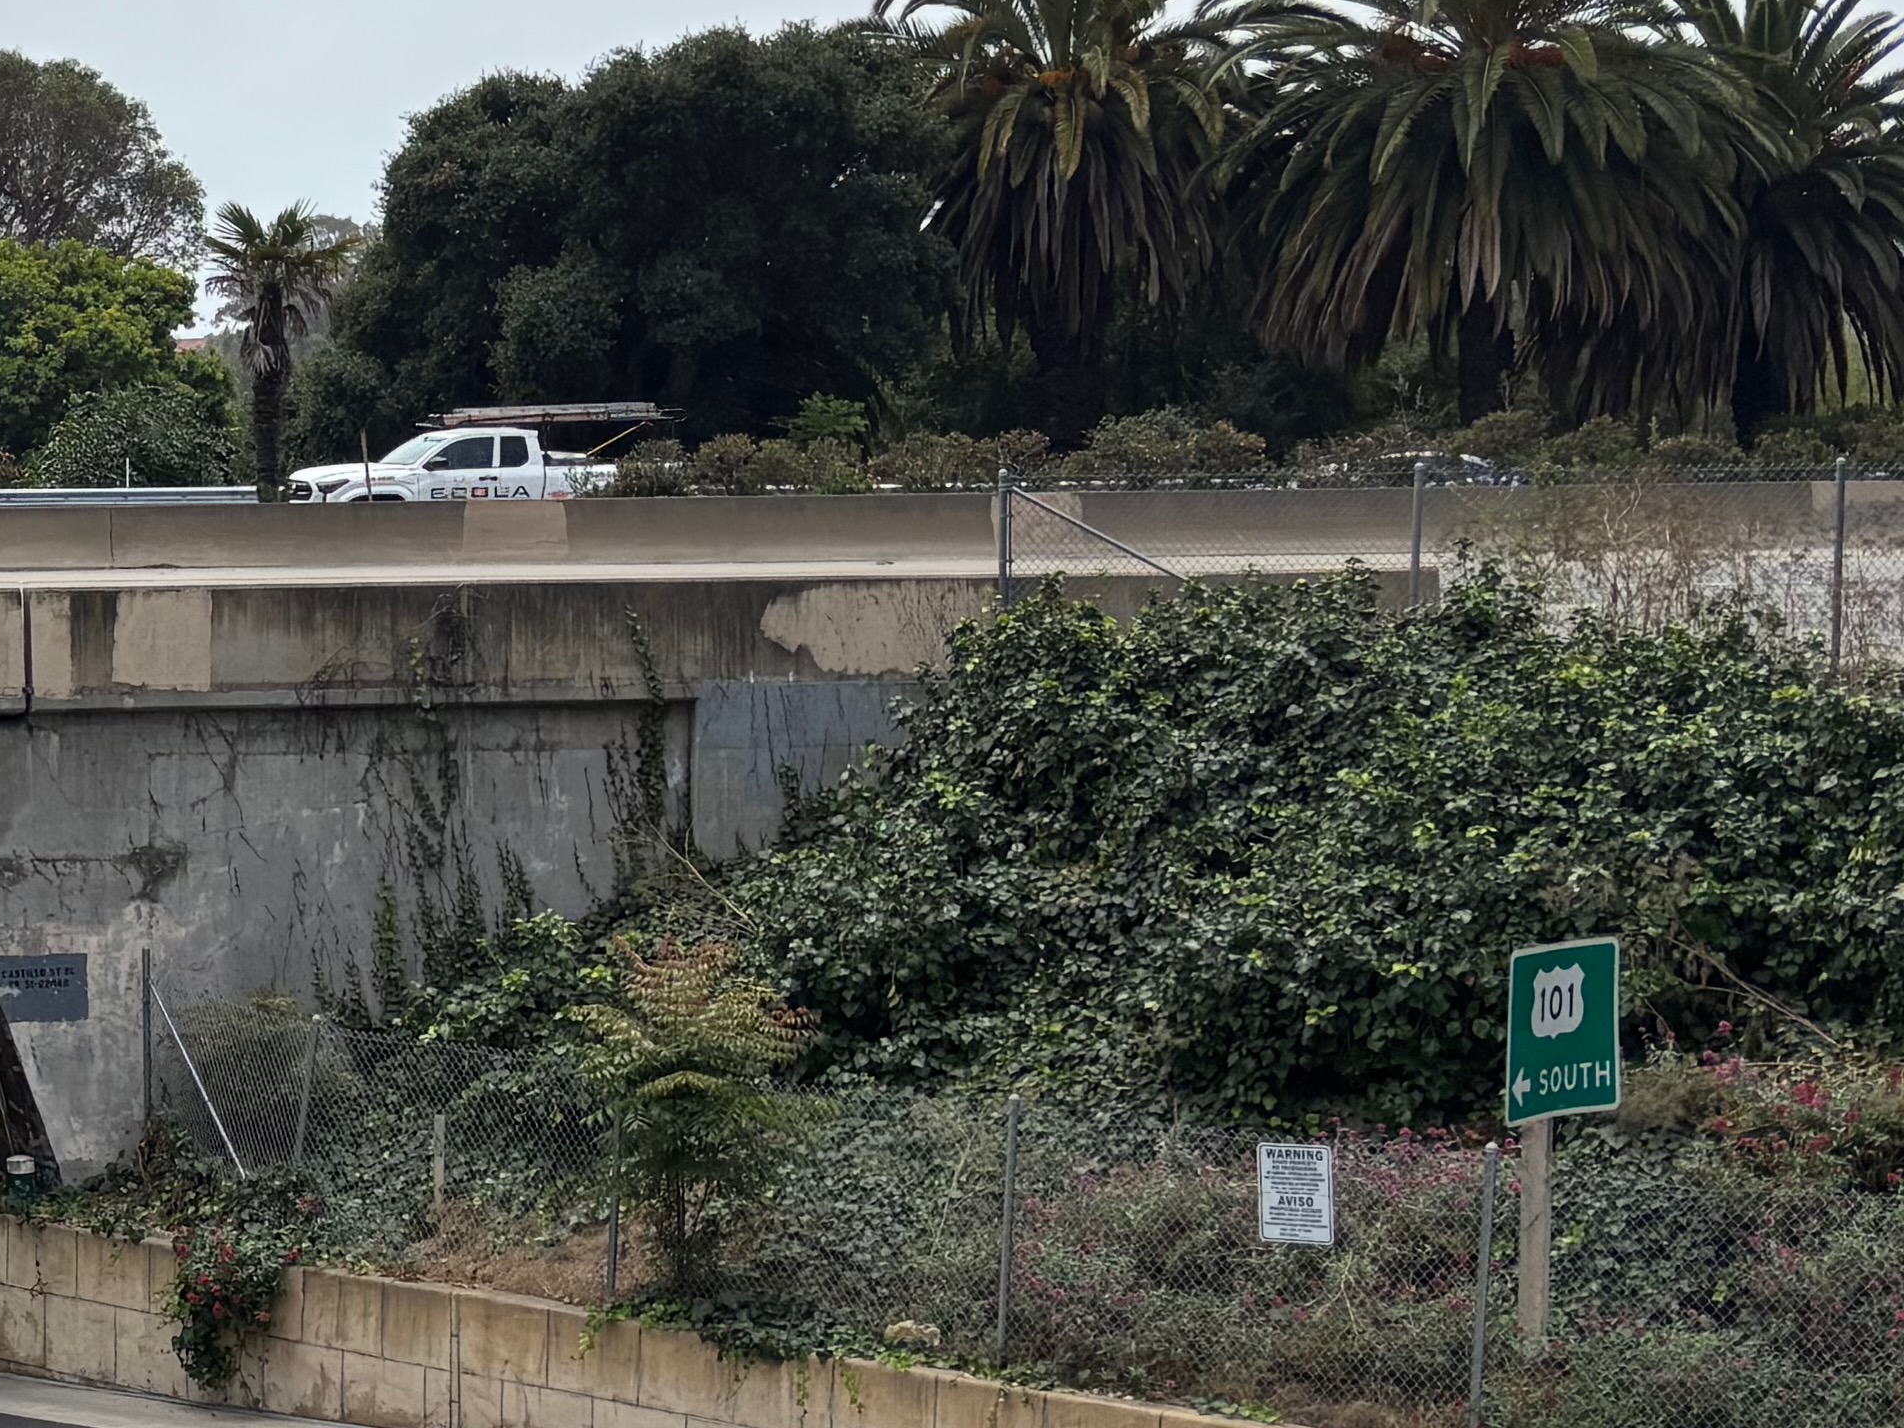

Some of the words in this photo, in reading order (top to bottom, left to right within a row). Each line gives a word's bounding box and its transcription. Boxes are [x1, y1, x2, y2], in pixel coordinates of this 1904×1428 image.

[1540, 982, 1574, 1023] 101
[1539, 1059, 1610, 1096] SOUTH
[1265, 1148, 1323, 1162] WARNING
[1278, 1195, 1314, 1208] AVISO
